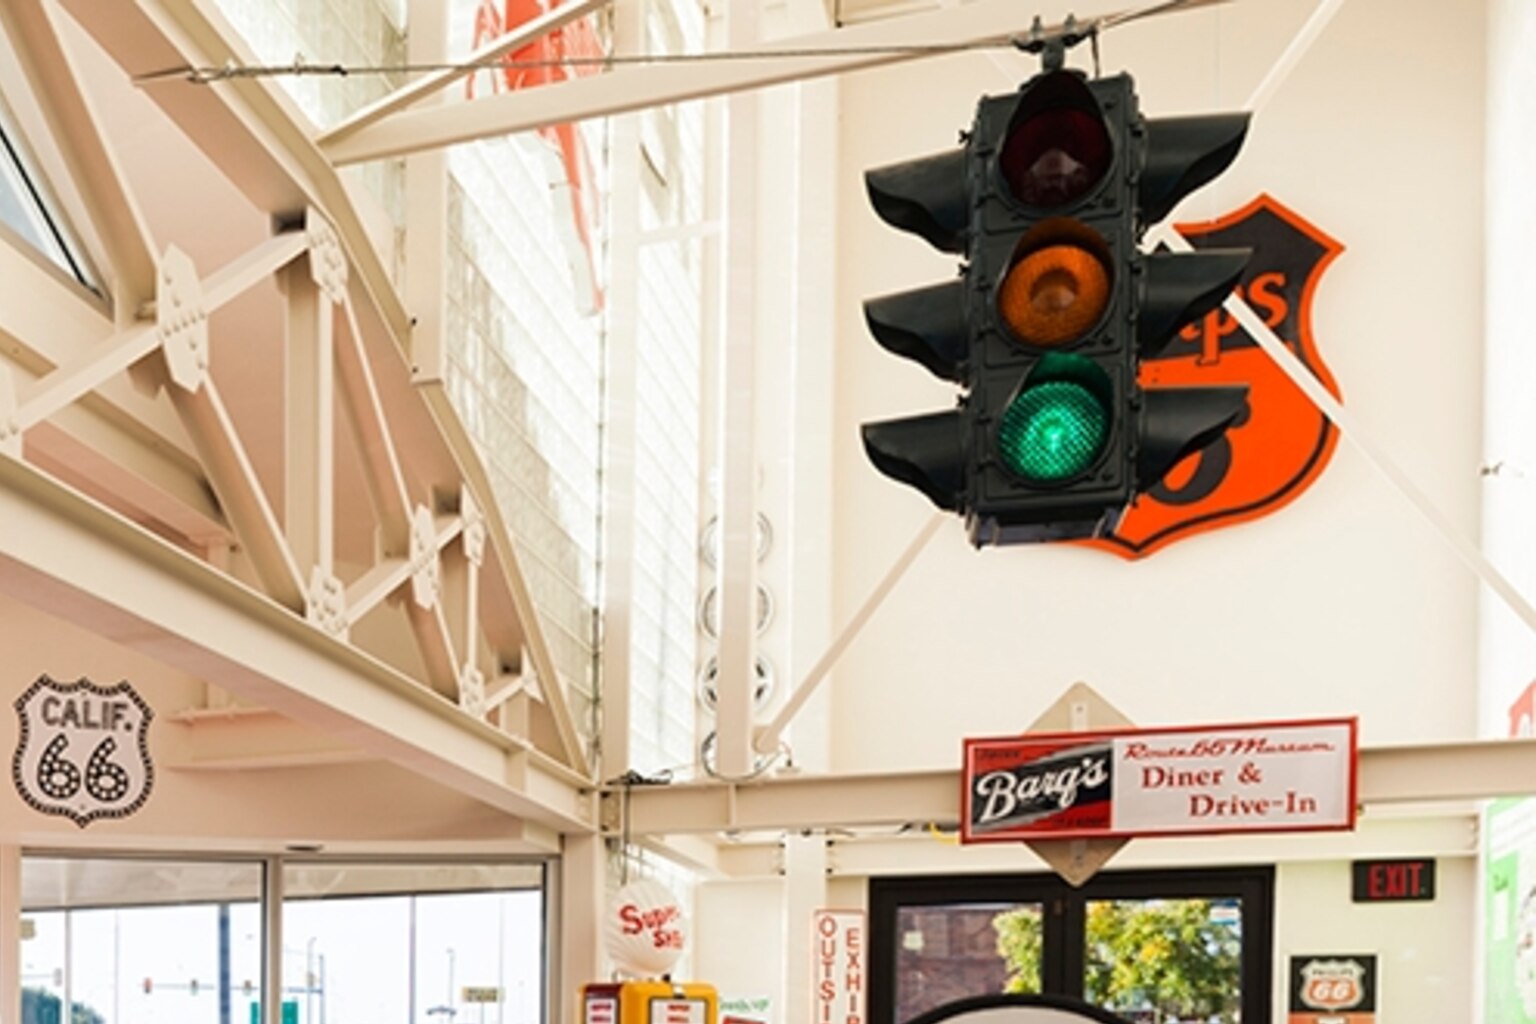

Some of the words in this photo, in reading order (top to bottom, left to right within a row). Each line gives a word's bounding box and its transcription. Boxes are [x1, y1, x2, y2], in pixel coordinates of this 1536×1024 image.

[40, 697, 134, 732] CALIF.
[36, 733, 130, 802] 66
[1141, 765, 1224, 789] Diner
[1237, 761, 1262, 784] &
[1189, 790, 1317, 818] Drive-In
[1367, 863, 1424, 898] EXIT
[1312, 981, 1352, 1001] 66
